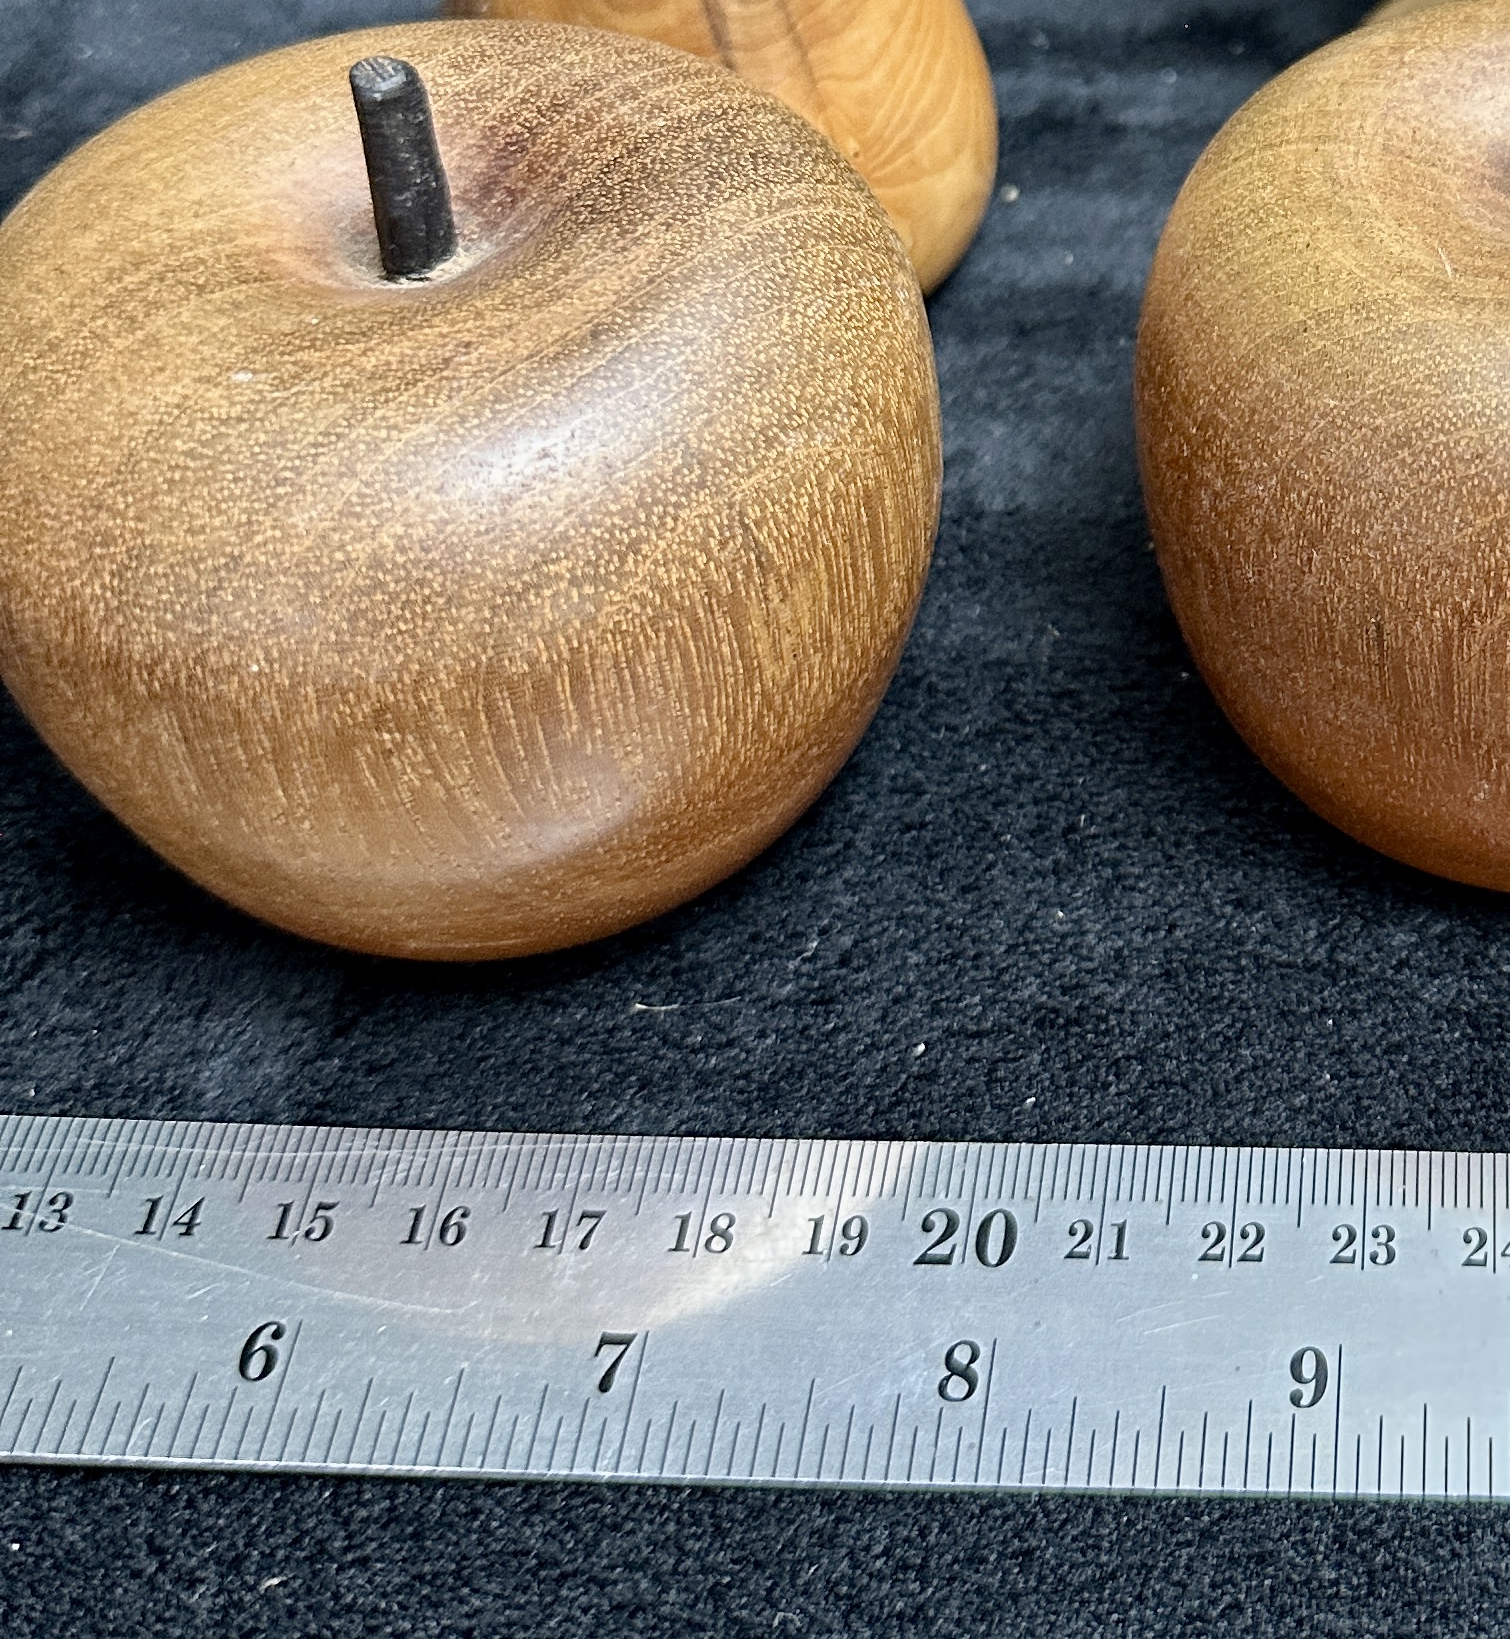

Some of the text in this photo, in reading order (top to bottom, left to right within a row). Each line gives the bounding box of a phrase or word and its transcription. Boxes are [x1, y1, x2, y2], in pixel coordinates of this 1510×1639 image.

[1, 1191, 75, 1232] 13
[134, 1195, 205, 1237] 14
[267, 1200, 339, 1242] 15
[400, 1204, 471, 1247] 16
[534, 1208, 607, 1250] 17
[667, 1211, 736, 1254] 18
[801, 1214, 869, 1257] 19
[913, 1207, 1019, 1267] 20
[1064, 1218, 1129, 1261] 21
[1199, 1221, 1266, 1264] 22
[1330, 1223, 1397, 1266] 23
[238, 1320, 287, 1382] 6
[592, 1331, 638, 1394] 7
[937, 1339, 982, 1403] 8
[1288, 1346, 1329, 1409] 9
